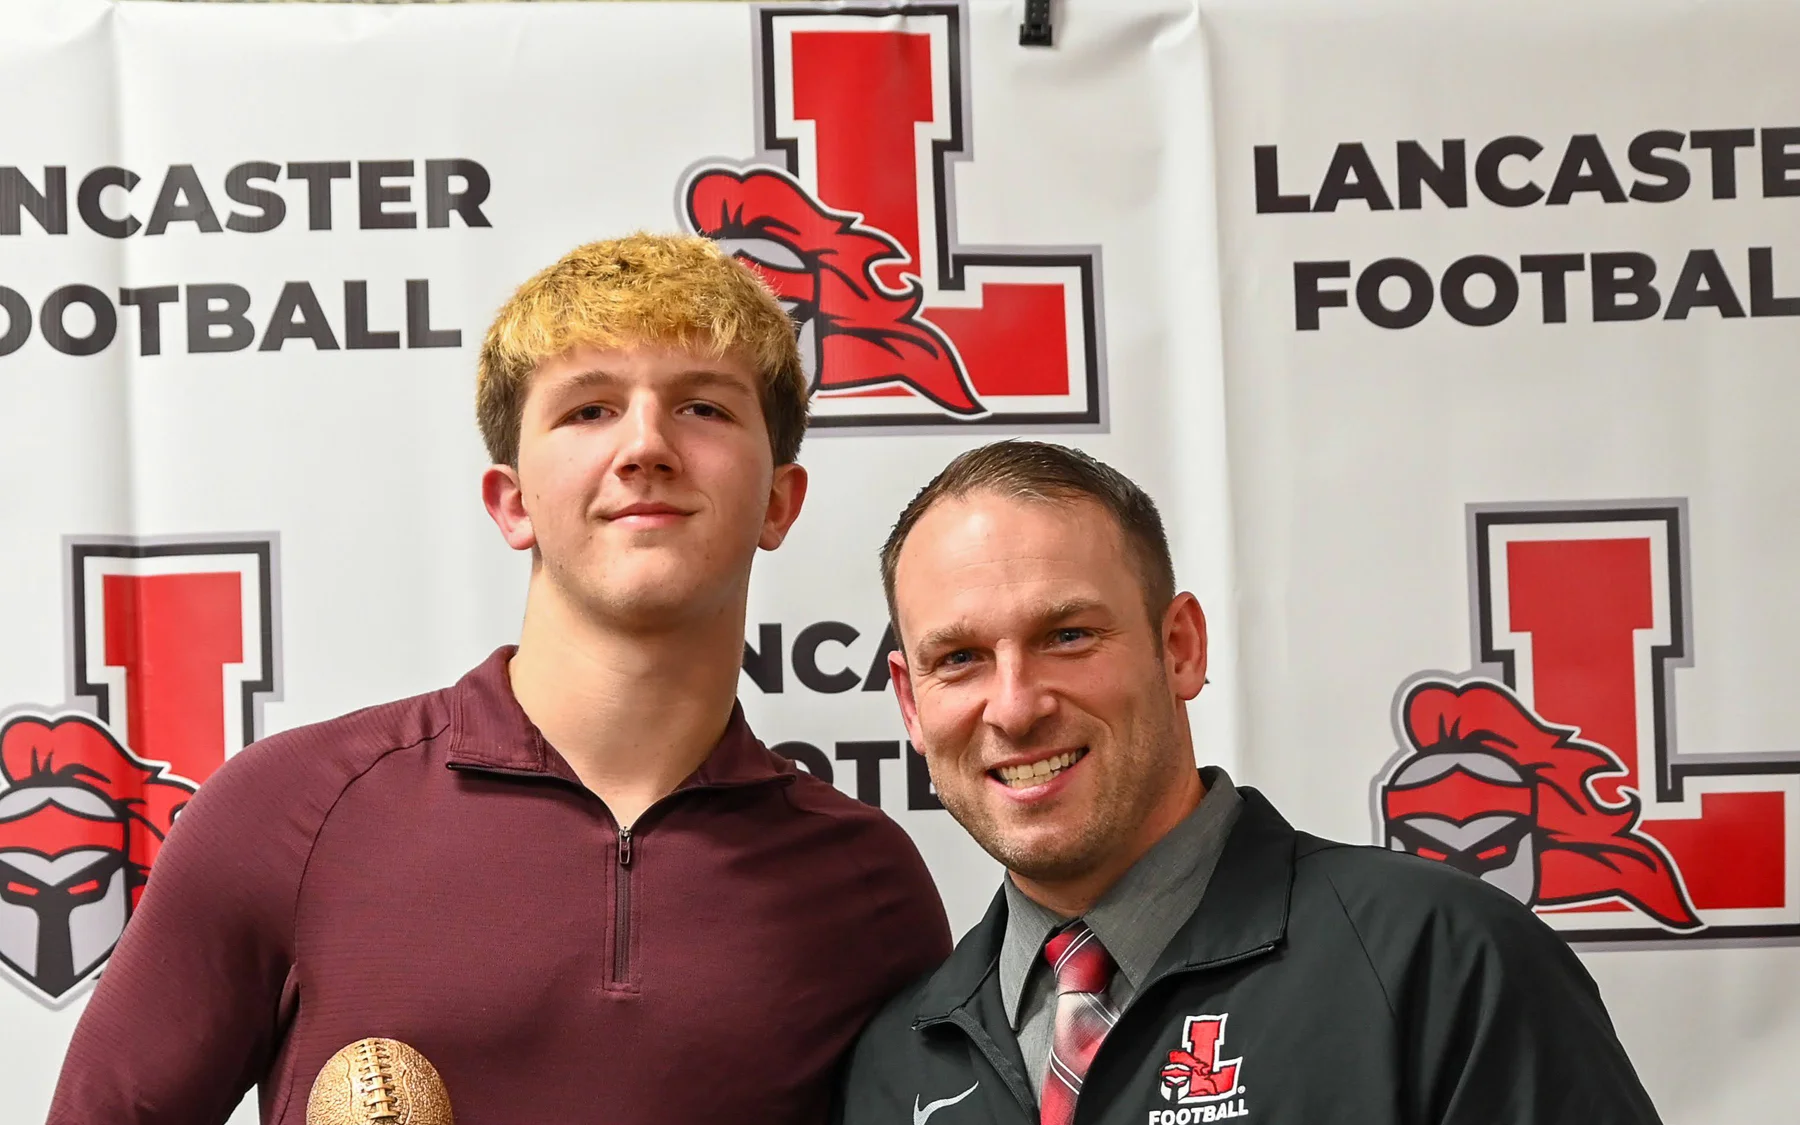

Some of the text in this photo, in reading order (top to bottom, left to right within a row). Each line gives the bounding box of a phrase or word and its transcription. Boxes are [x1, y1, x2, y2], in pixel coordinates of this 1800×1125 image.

[0, 158, 493, 239] NCASTER
[1254, 127, 1800, 214] LANCASTE
[1294, 246, 1800, 331] FOOTBAL
